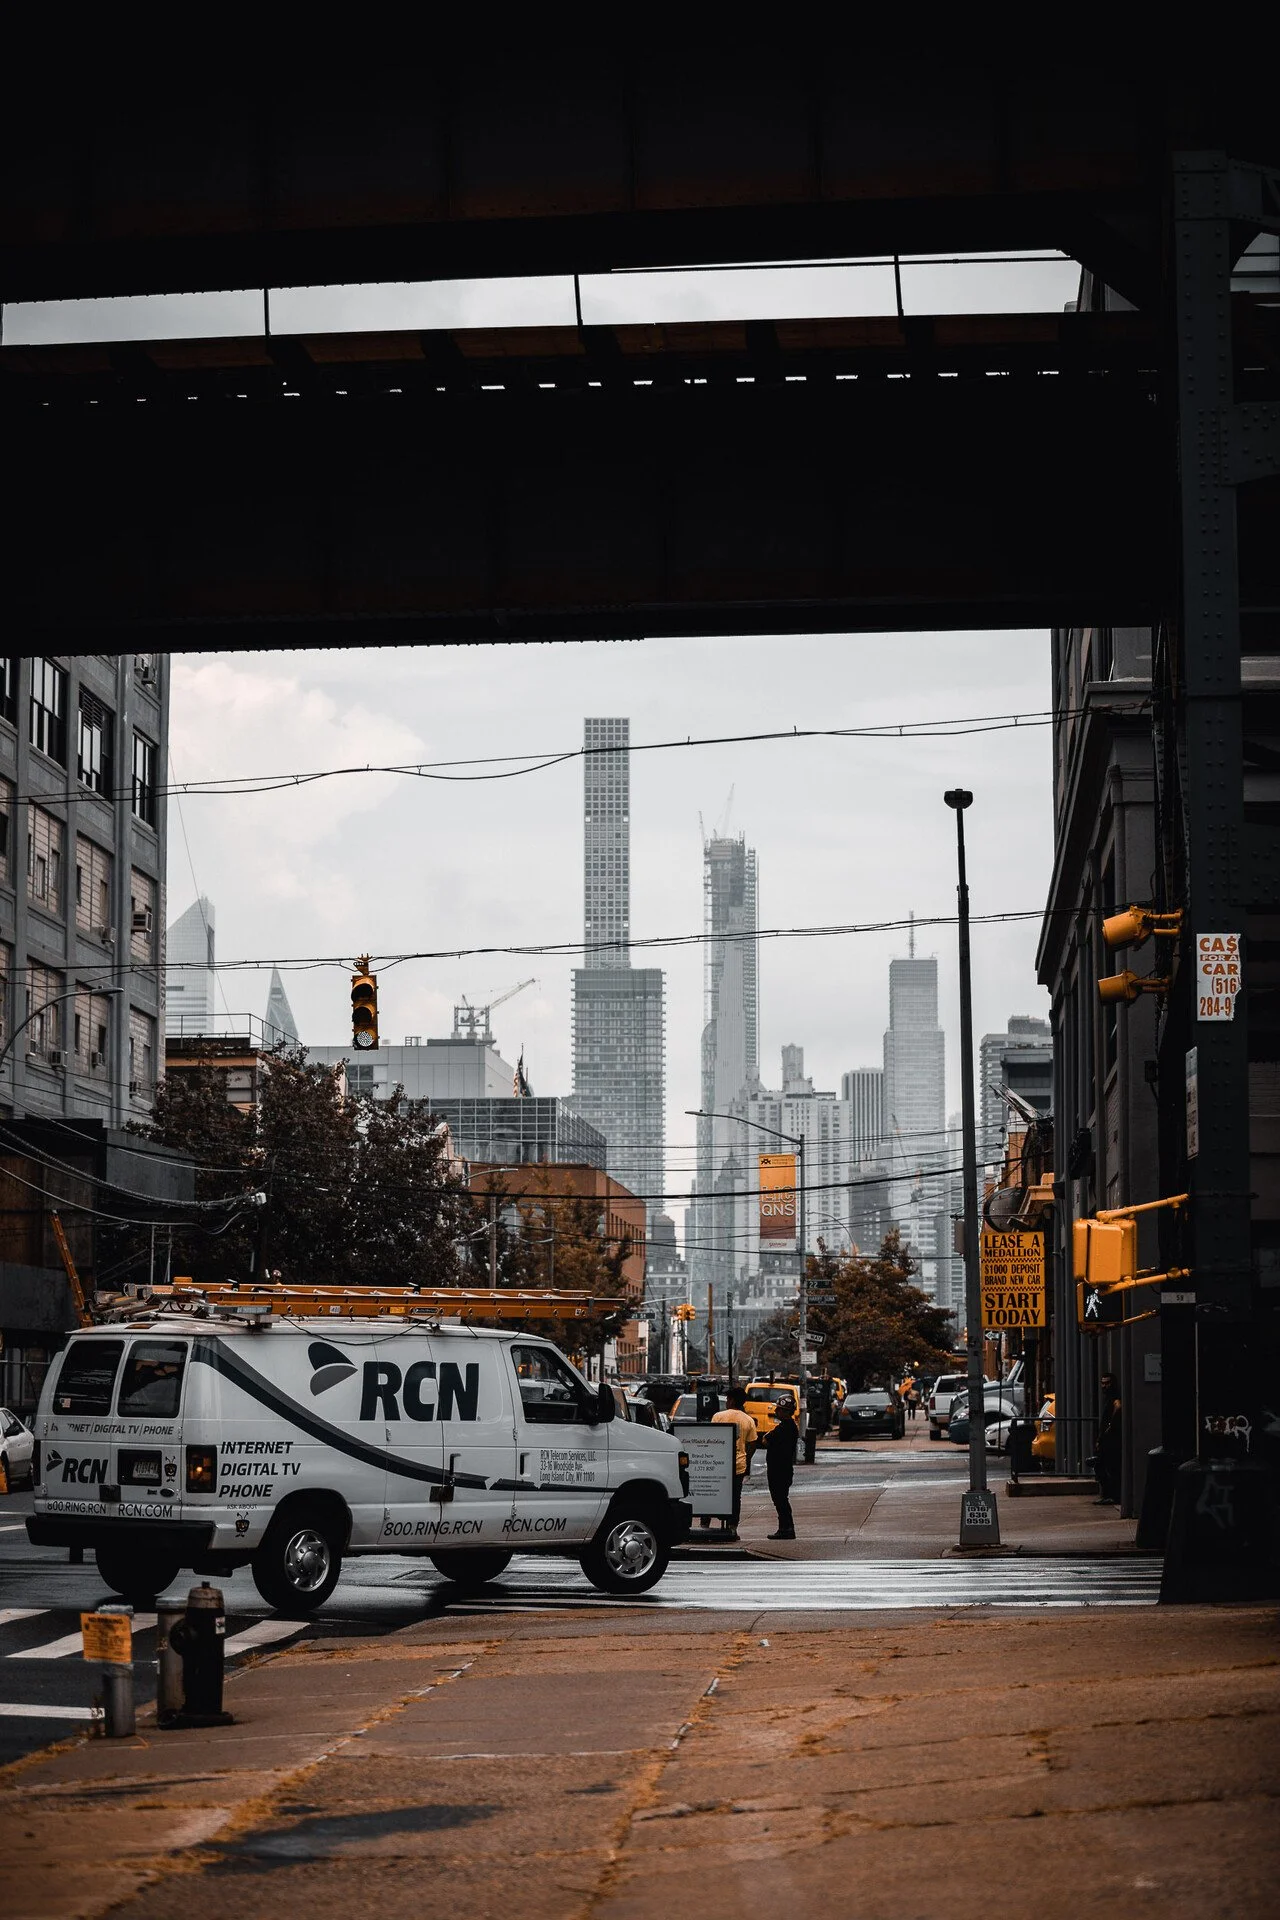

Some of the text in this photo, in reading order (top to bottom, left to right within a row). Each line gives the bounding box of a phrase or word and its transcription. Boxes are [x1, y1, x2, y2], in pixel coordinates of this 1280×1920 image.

[1199, 936, 1237, 953] CA$
[1202, 963, 1239, 975] CAR
[761, 1203, 795, 1216] QNS
[984, 1234, 1040, 1248] LEASE A
[984, 1248, 1040, 1258] MEDALLION
[984, 1263, 1041, 1275] $1000 DEPOSIT
[808, 1281, 818, 1289] 22
[984, 1274, 1041, 1286] BRAND NEW CAR
[984, 1292, 1041, 1309] START
[984, 1309, 1041, 1326] TODAY
[359, 1360, 480, 1422] RCN
[702, 1395, 711, 1407] P
[93, 1424, 126, 1434] DIGITAL
[128, 1425, 139, 1434] TV
[142, 1426, 174, 1435] PHONE
[220, 1441, 294, 1455] INTERNET
[550, 1449, 568, 1461] Telecom
[61, 1458, 109, 1484] RCN
[220, 1462, 301, 1477] DIGITAL TV
[553, 1460, 575, 1472] Woodside
[540, 1471, 551, 1483] Long
[551, 1471, 565, 1482] Island
[576, 1471, 583, 1482] NY
[219, 1484, 274, 1498] PHONE
[118, 1504, 173, 1518] RCN.COM
[383, 1517, 568, 1536] 800.RING.RCN RCN.COM
